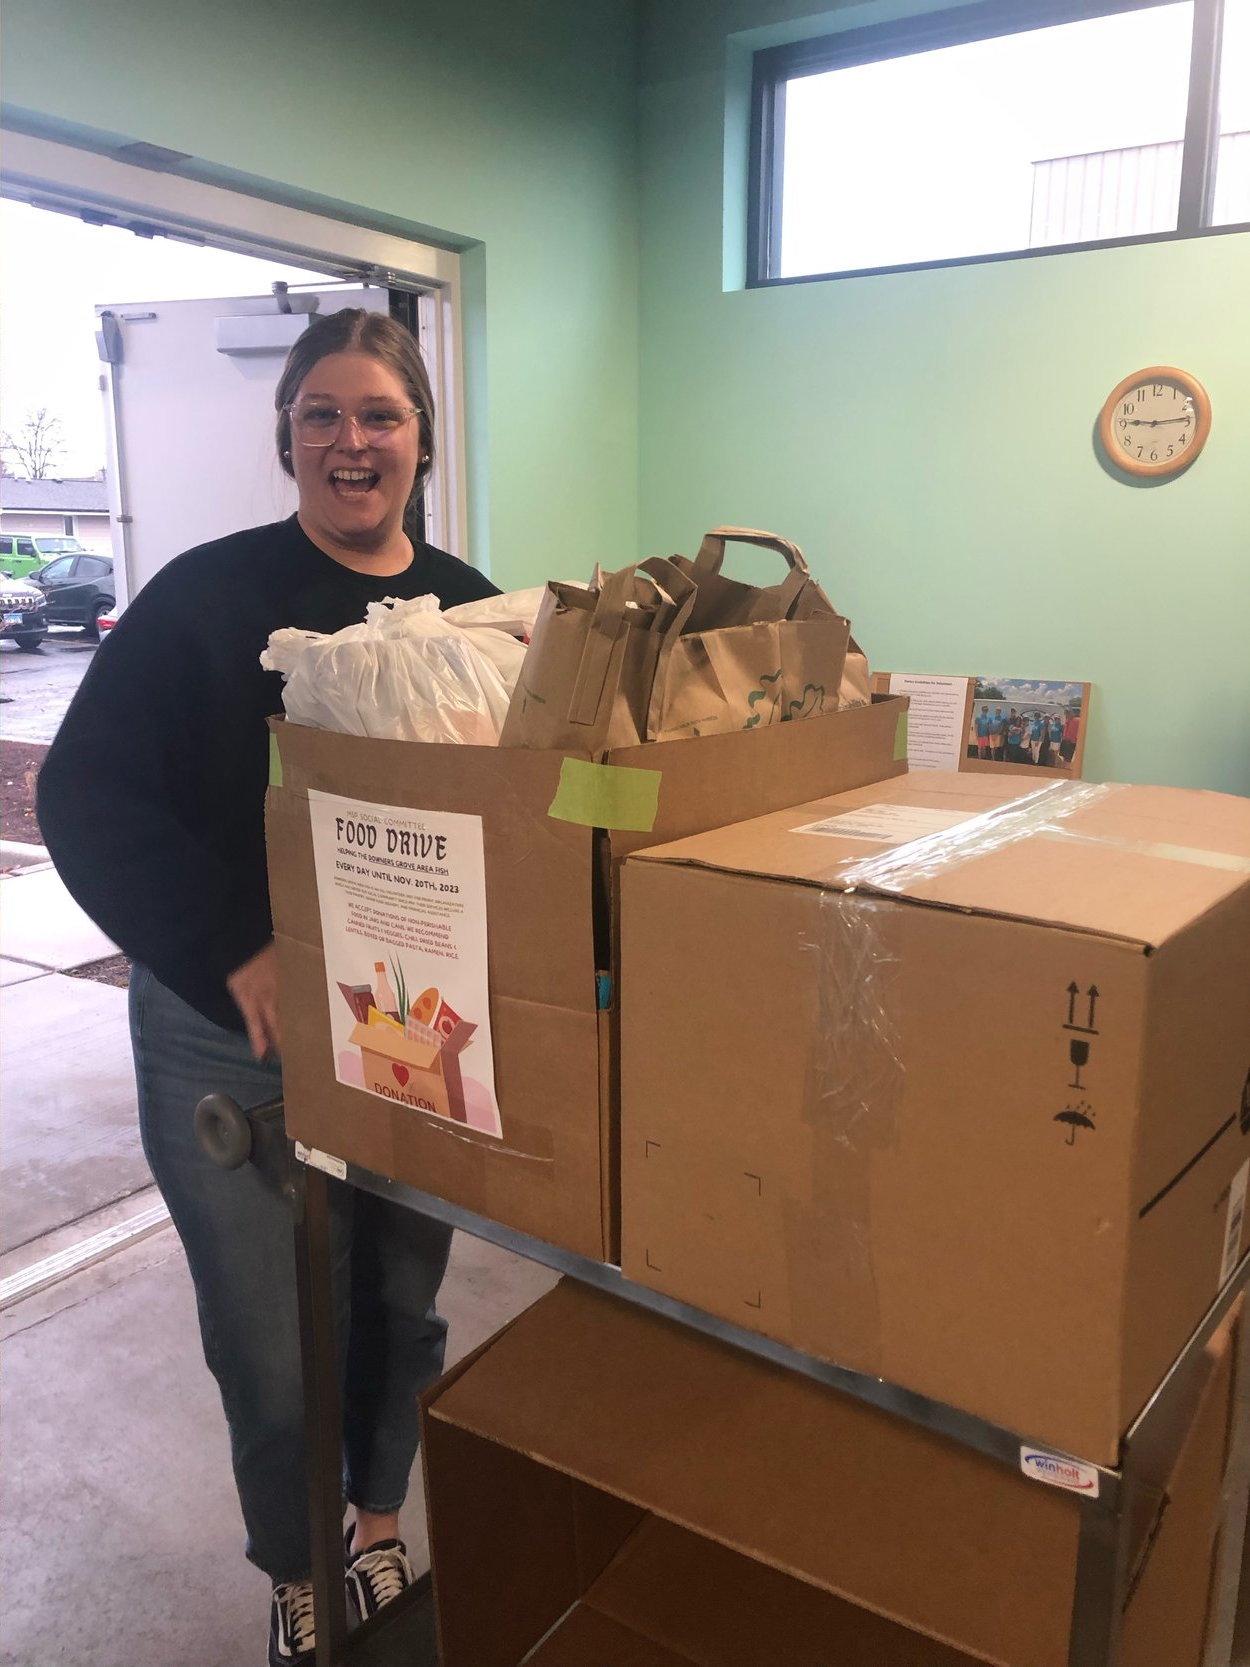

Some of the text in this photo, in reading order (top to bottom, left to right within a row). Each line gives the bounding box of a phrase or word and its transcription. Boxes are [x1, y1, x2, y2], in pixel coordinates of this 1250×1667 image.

[1137, 389, 1145, 402] 11
[1152, 384, 1163, 397] 12
[1172, 387, 1177, 400] 1
[1123, 402, 1135, 415] 10
[1119, 419, 1127, 431] 9
[1123, 435, 1132, 447] 8
[1178, 433, 1186, 445] 4
[1137, 446, 1143, 458] 7
[1150, 449, 1158, 461] 6
[1166, 445, 1174, 457] 5
[384, 818, 426, 831] COMMITTEE
[335, 817, 447, 861] FOOD DRIVE
[336, 847, 449, 876] HELPING THE DOWNERS GROVE AREA FISH
[335, 860, 355, 873] EVERY
[356, 866, 370, 877] DAY
[371, 870, 392, 882] UNTIL
[439, 883, 459, 893] 2023
[374, 1082, 437, 1114] DONATION
[1034, 1458, 1080, 1480] winholt
